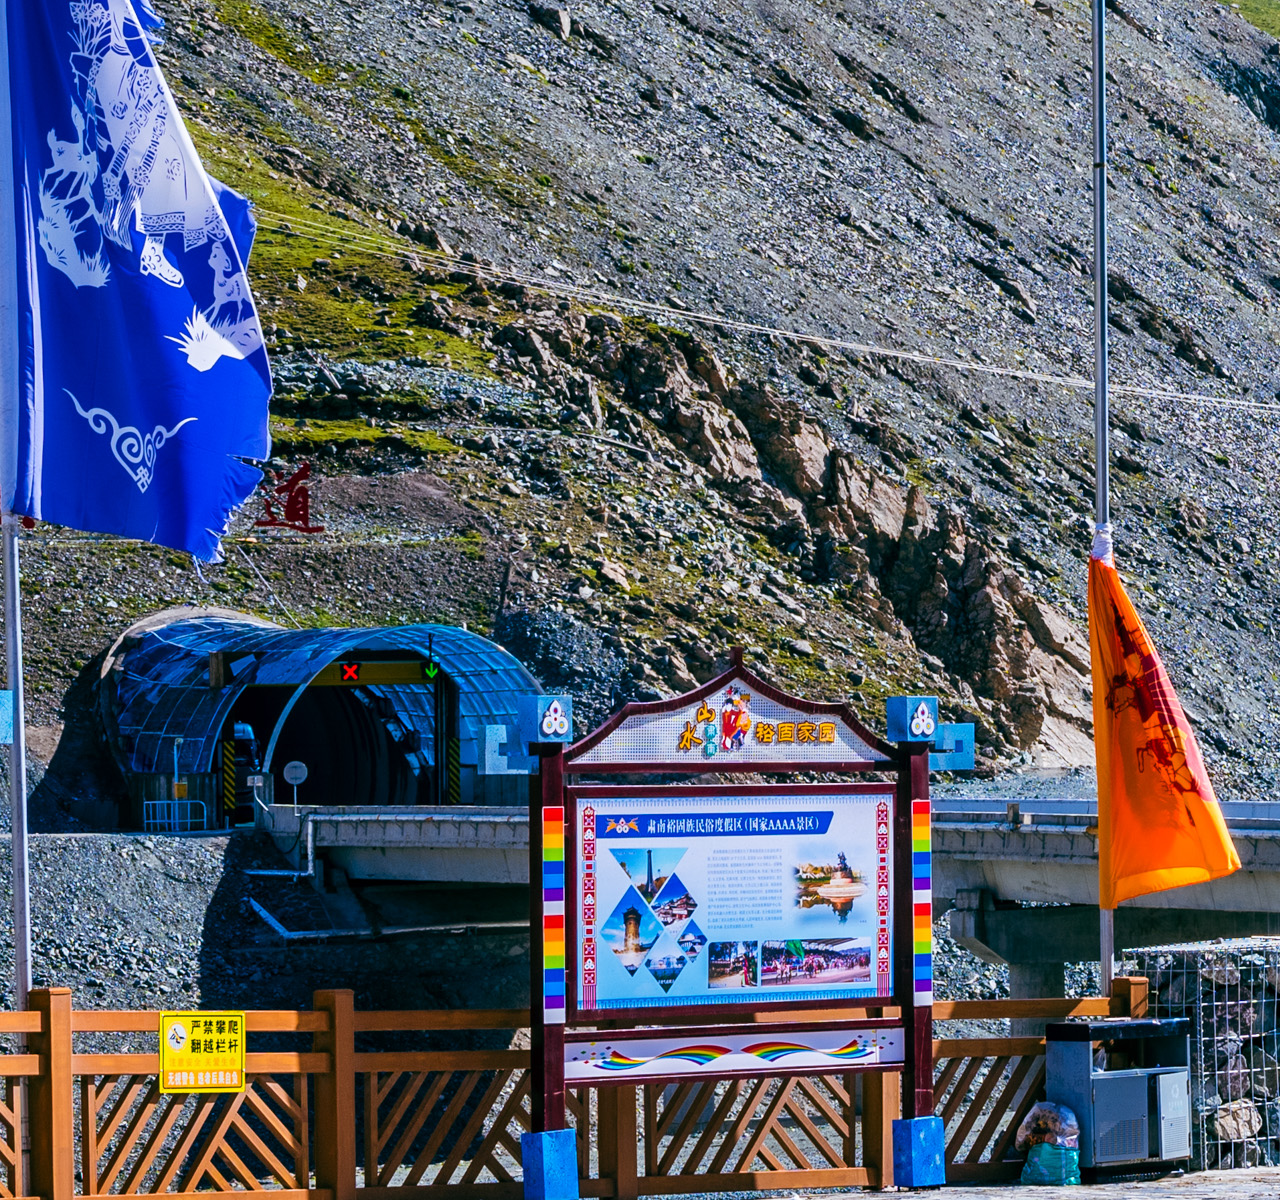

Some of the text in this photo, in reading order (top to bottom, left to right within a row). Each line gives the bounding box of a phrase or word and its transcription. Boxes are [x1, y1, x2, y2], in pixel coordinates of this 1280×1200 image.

[755, 720, 836, 744] 裕固家园
[190, 1020, 239, 1035] 严禁攀爬
[190, 1039, 239, 1054] 翻越栏杆
